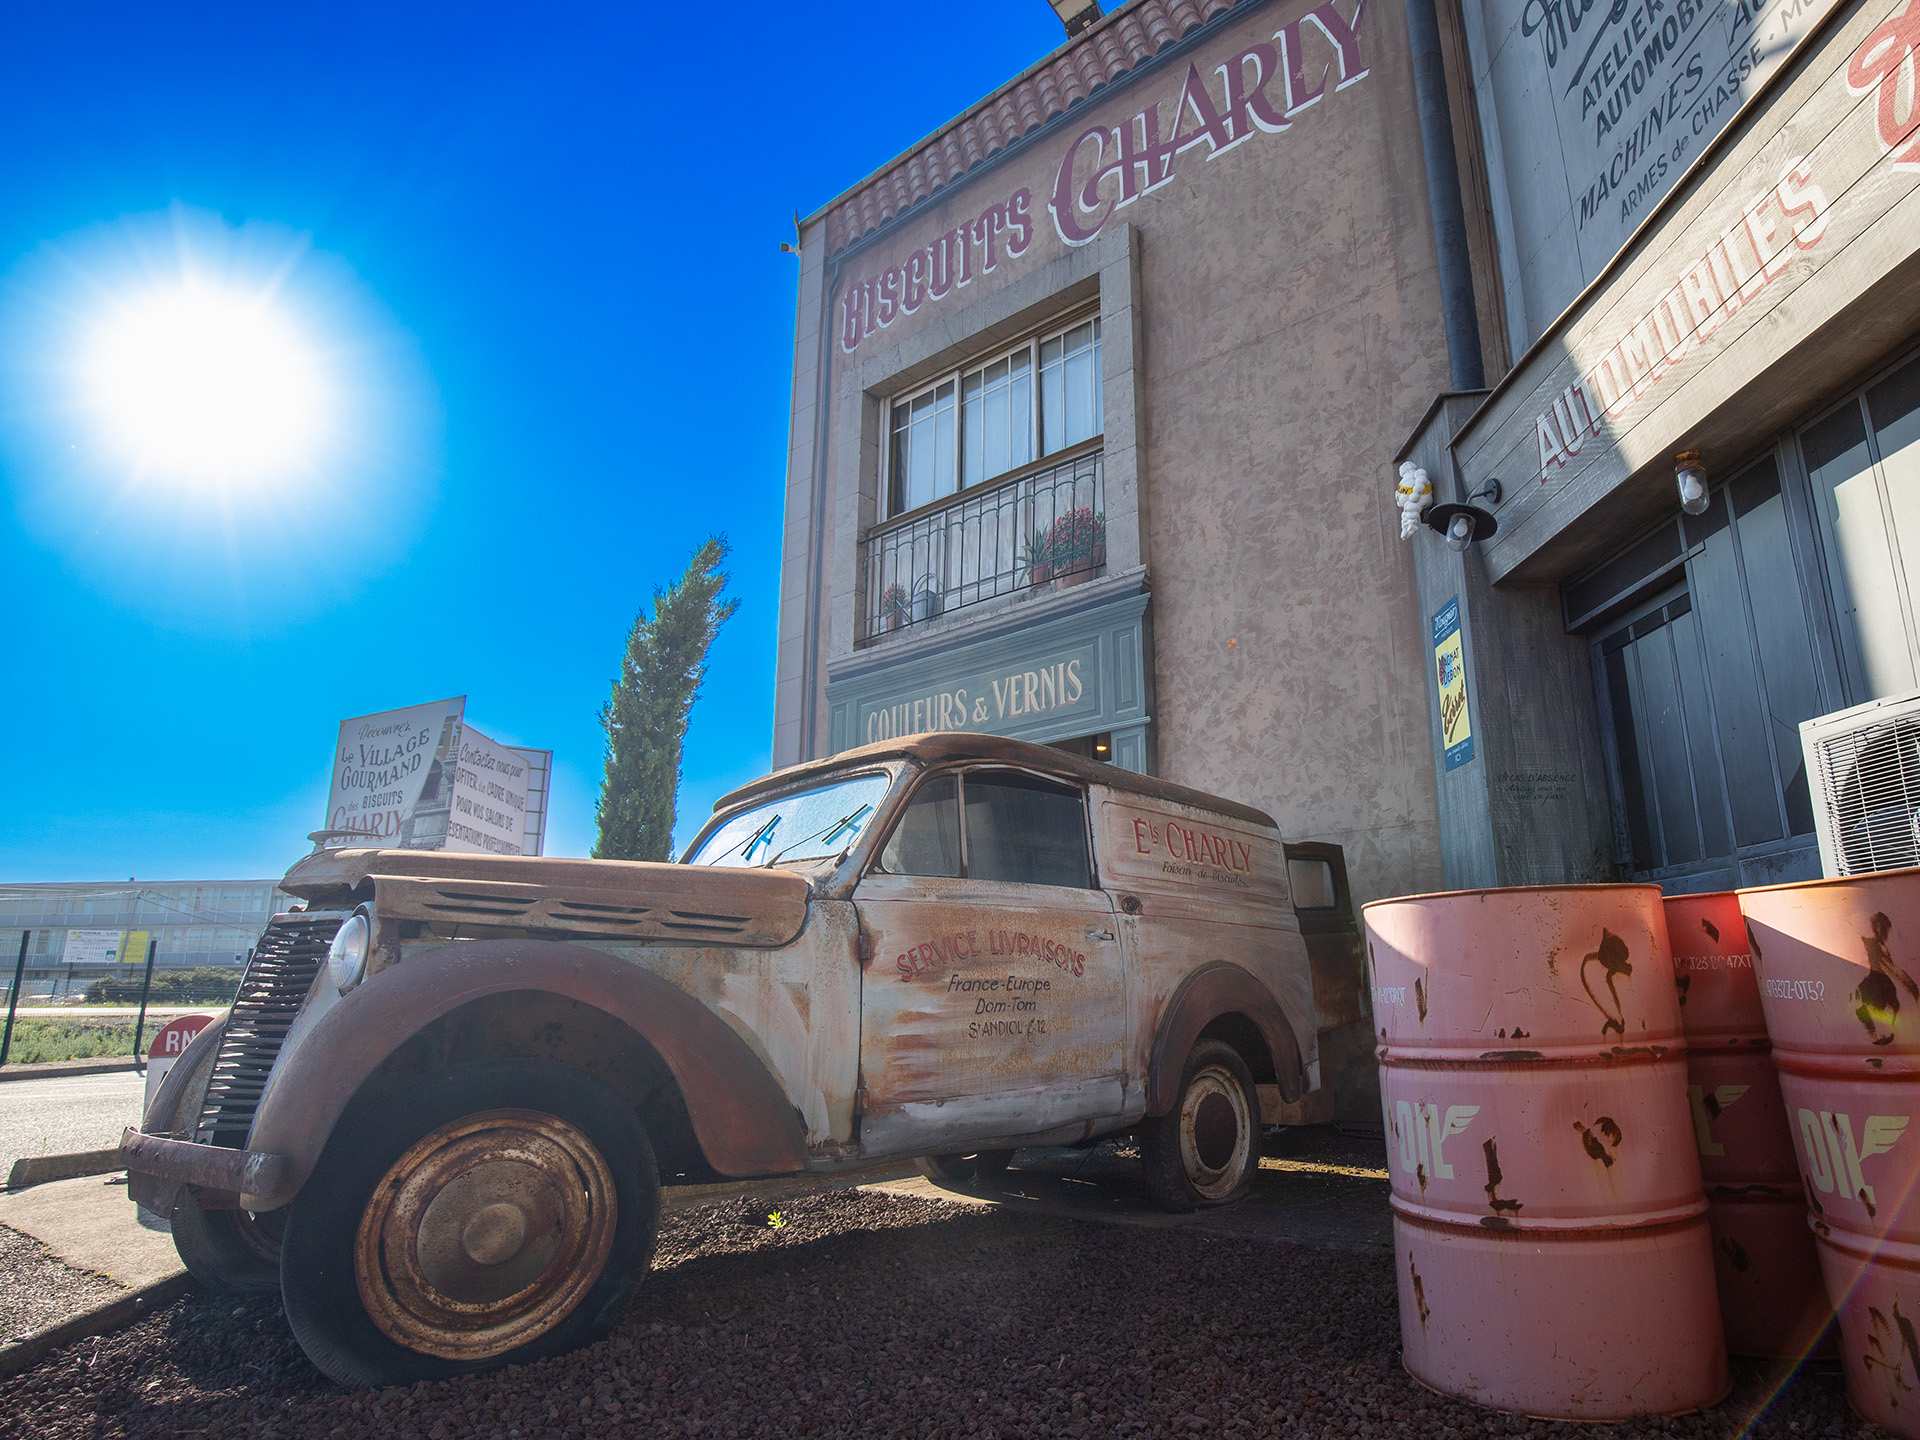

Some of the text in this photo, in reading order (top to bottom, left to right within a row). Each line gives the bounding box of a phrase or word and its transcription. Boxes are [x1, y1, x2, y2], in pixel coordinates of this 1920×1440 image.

[1579, 52, 1704, 232] MACHINES
[1621, 153, 1668, 224] ARMES
[1671, 135, 1690, 162] de
[1692, 37, 1766, 136] CHASSE
[841, 0, 1371, 353] BISCUITS CHARLY
[1536, 155, 1831, 486] AUTOMOBILES
[867, 659, 1083, 743] COULEURS & VERNIS
[341, 728, 430, 768] Le VILLAGE
[460, 743, 524, 781] Contactez nous pour
[341, 753, 422, 792] GOURMAND
[1510, 774, 1525, 782] CAS
[1527, 773, 1577, 782] D'ABSENCE
[348, 790, 403, 812] des BISCUITS
[456, 795, 514, 832] POUR VOS SALONS DE
[330, 805, 408, 844] CHARLY
[447, 821, 483, 847] ESENTATIONS
[1165, 821, 1252, 875] CHARLY
[1162, 861, 1192, 877] Faiseur
[1197, 868, 1207, 879] de
[897, 930, 1086, 982] SERVICE LIVRAISONS
[947, 974, 1051, 995] France-Europe
[974, 996, 1037, 1015] Dom-Tom
